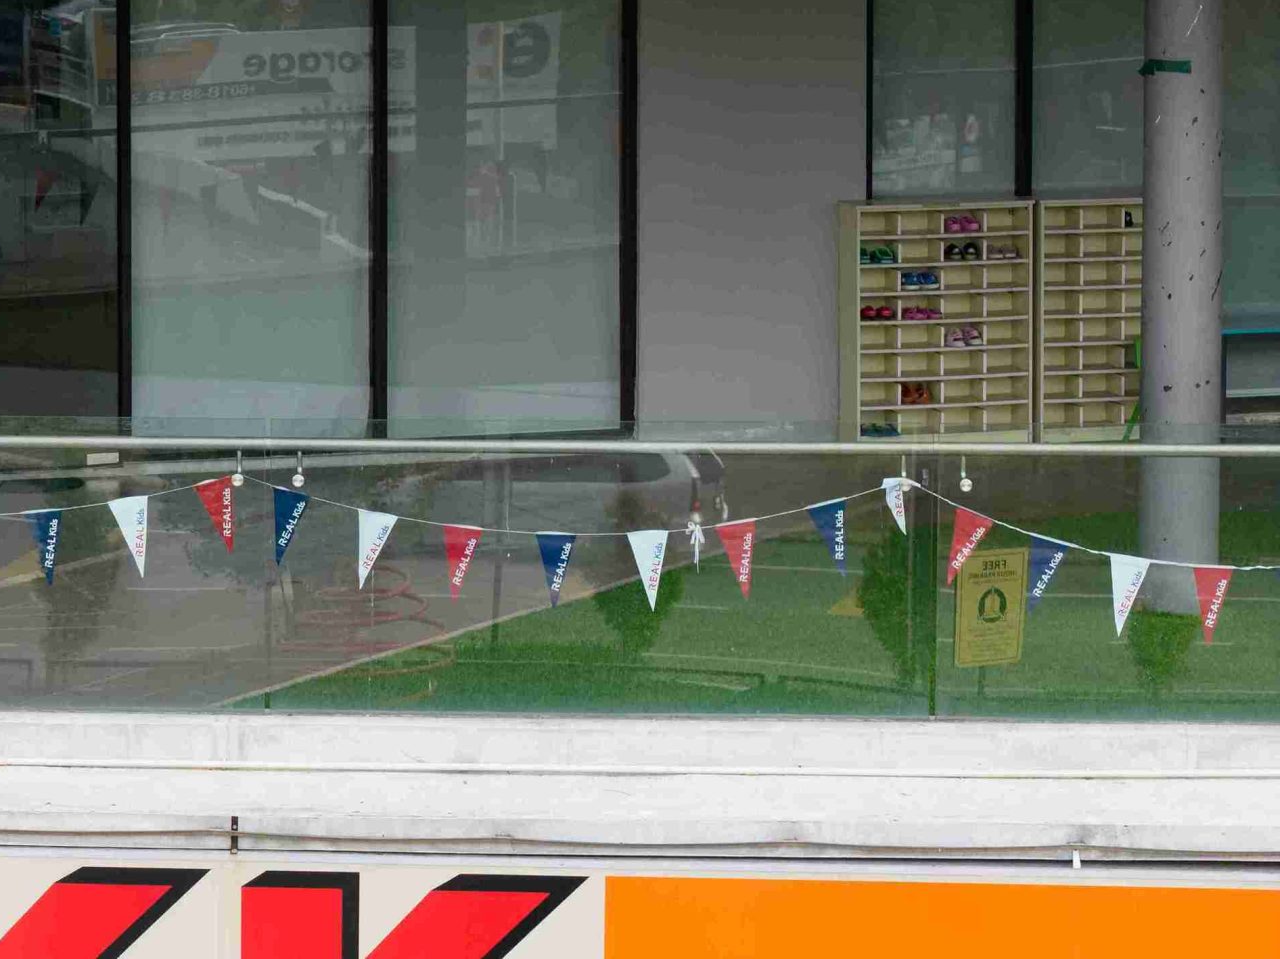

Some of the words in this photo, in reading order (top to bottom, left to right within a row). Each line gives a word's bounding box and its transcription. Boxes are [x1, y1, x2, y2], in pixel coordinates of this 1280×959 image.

[293, 500, 306, 518] Kids
[49, 519, 59, 536] Kids
[836, 511, 844, 528] Kids
[743, 532, 753, 550] Kids
[971, 526, 987, 544] Kids
[465, 538, 478, 556] Kids
[561, 542, 573, 560] Kids
[1049, 551, 1064, 569] Kids
[1216, 579, 1228, 597] Kids
